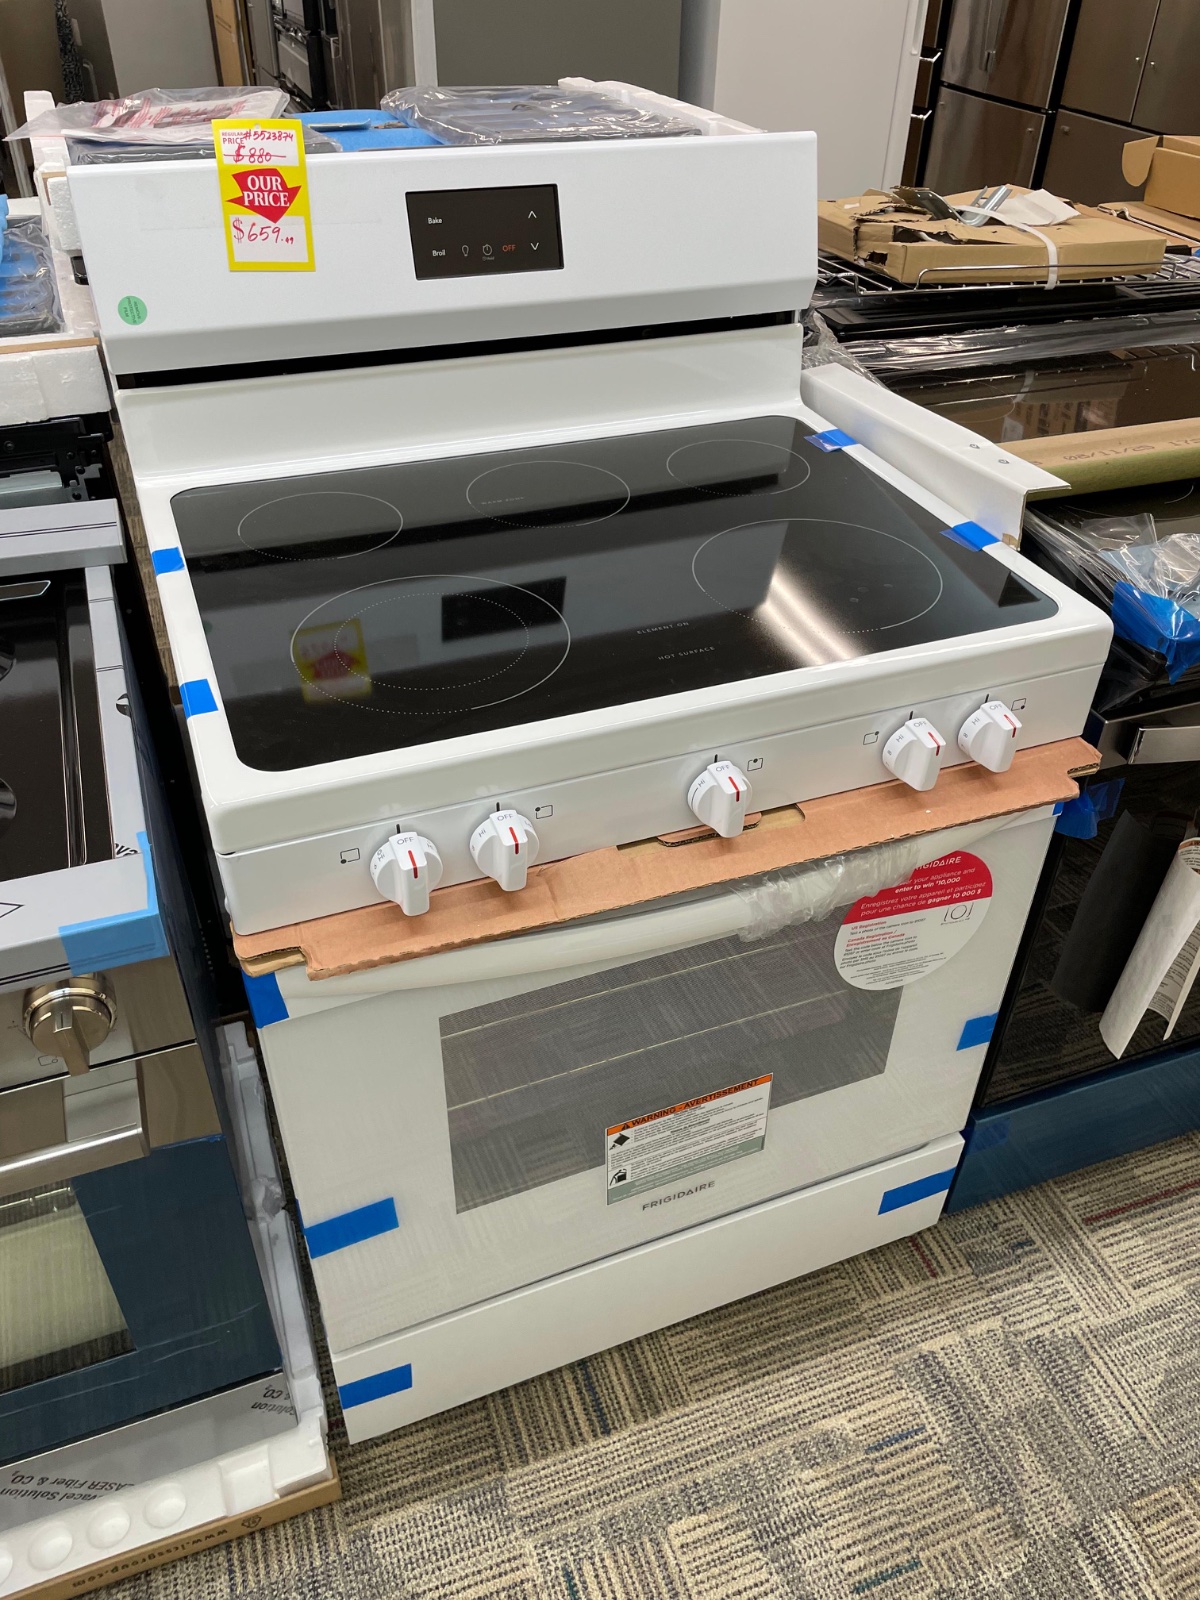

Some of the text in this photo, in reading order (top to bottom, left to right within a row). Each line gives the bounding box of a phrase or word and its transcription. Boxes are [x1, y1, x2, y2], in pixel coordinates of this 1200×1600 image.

[222, 137, 245, 145] PRICE
[246, 175, 283, 191] OUR
[243, 191, 290, 207] PRICE
[427, 217, 443, 225] Bake
[432, 249, 446, 257] Broil
[502, 244, 517, 252] OFF
[637, 624, 674, 635] ELEMENT
[658, 646, 716, 661] HOT SURFACE
[913, 720, 928, 728] OFF
[715, 764, 730, 772] OFF
[496, 813, 513, 822] OFF
[396, 836, 415, 846] OFF
[913, 876, 930, 884] your
[963, 867, 976, 875] and
[895, 885, 913, 894] enter
[860, 898, 899, 910] Enregistrez
[901, 894, 918, 902] votre
[860, 908, 878, 918] pour
[892, 901, 917, 910] chance
[927, 895, 952, 905] gagner
[961, 889, 976, 897] 000
[631, 1107, 677, 1126] WARNING
[684, 1079, 759, 1109] AVERTISSEMENT
[642, 1180, 716, 1211] FRIGIDAIRE
[37, 1476, 50, 1486] &
[50, 1477, 89, 1490] Fiber
[0, 1487, 60, 1502] Solution
